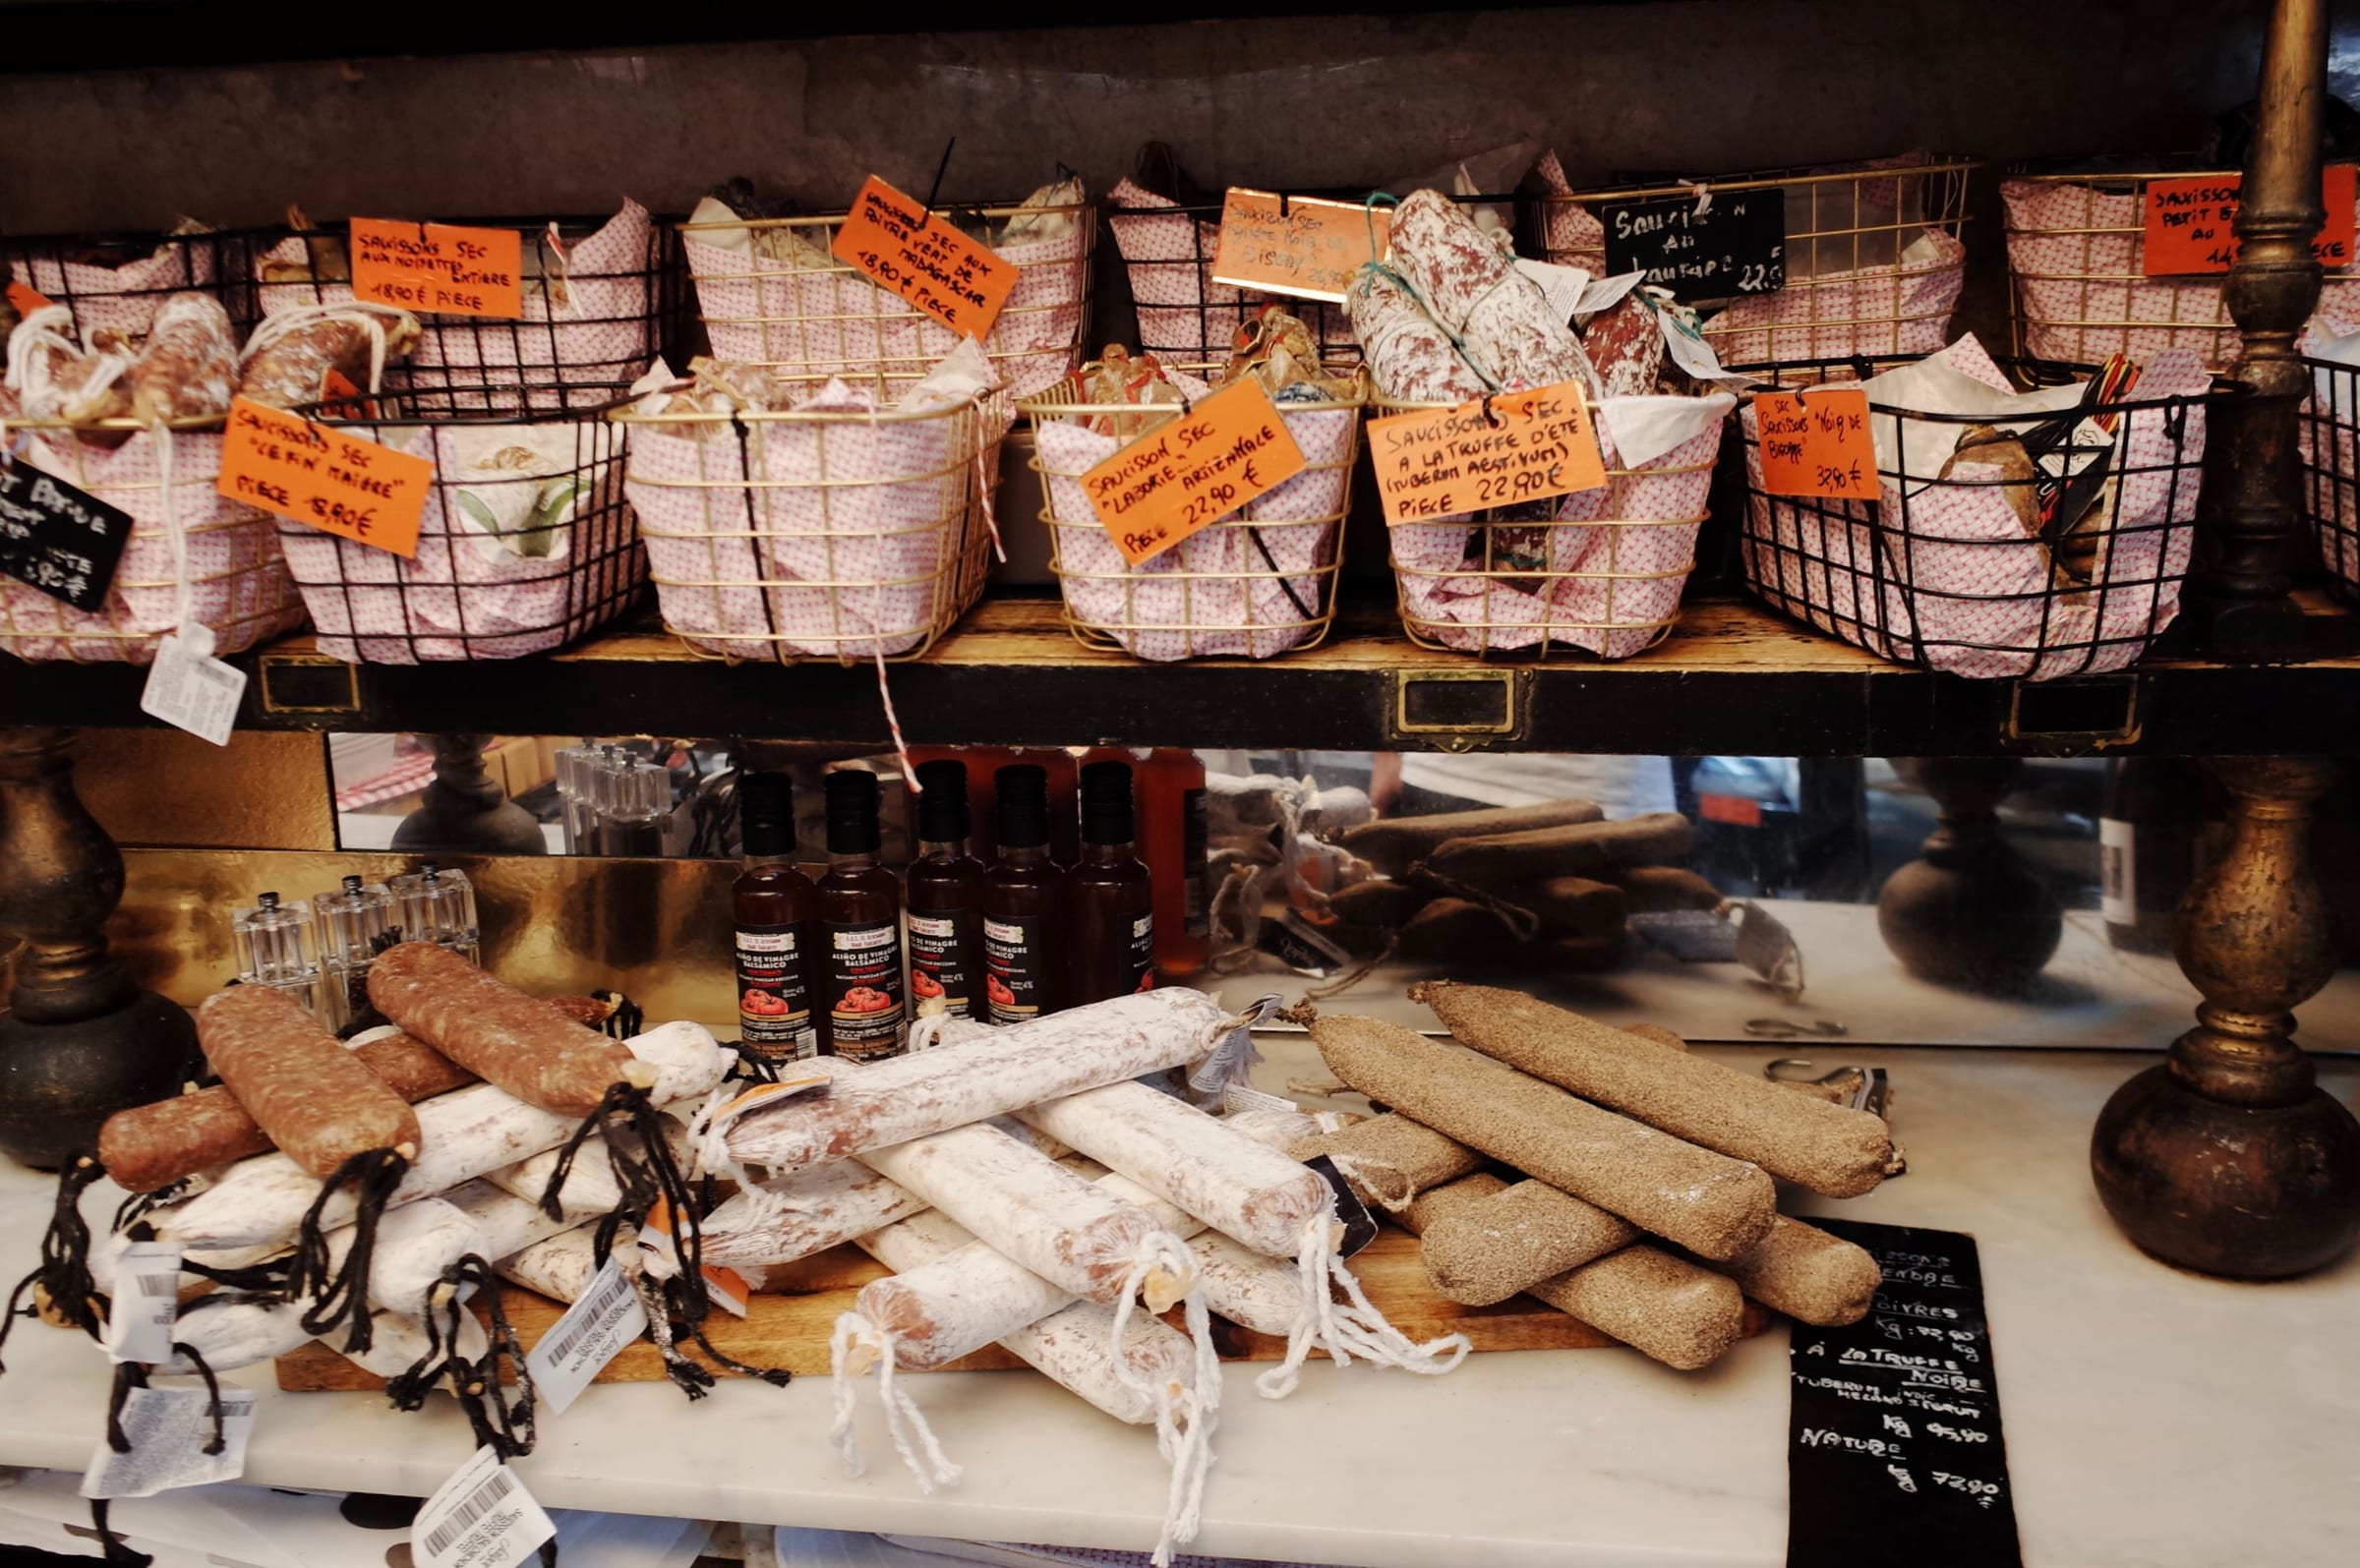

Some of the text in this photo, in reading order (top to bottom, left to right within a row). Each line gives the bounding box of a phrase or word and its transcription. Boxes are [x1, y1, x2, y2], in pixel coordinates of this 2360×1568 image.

[930, 232, 959, 253] SEC
[965, 255, 992, 276] AUX
[955, 265, 973, 283] DE
[1178, 422, 1215, 448] SEC
[1800, 1427, 1902, 1457] NATURE
